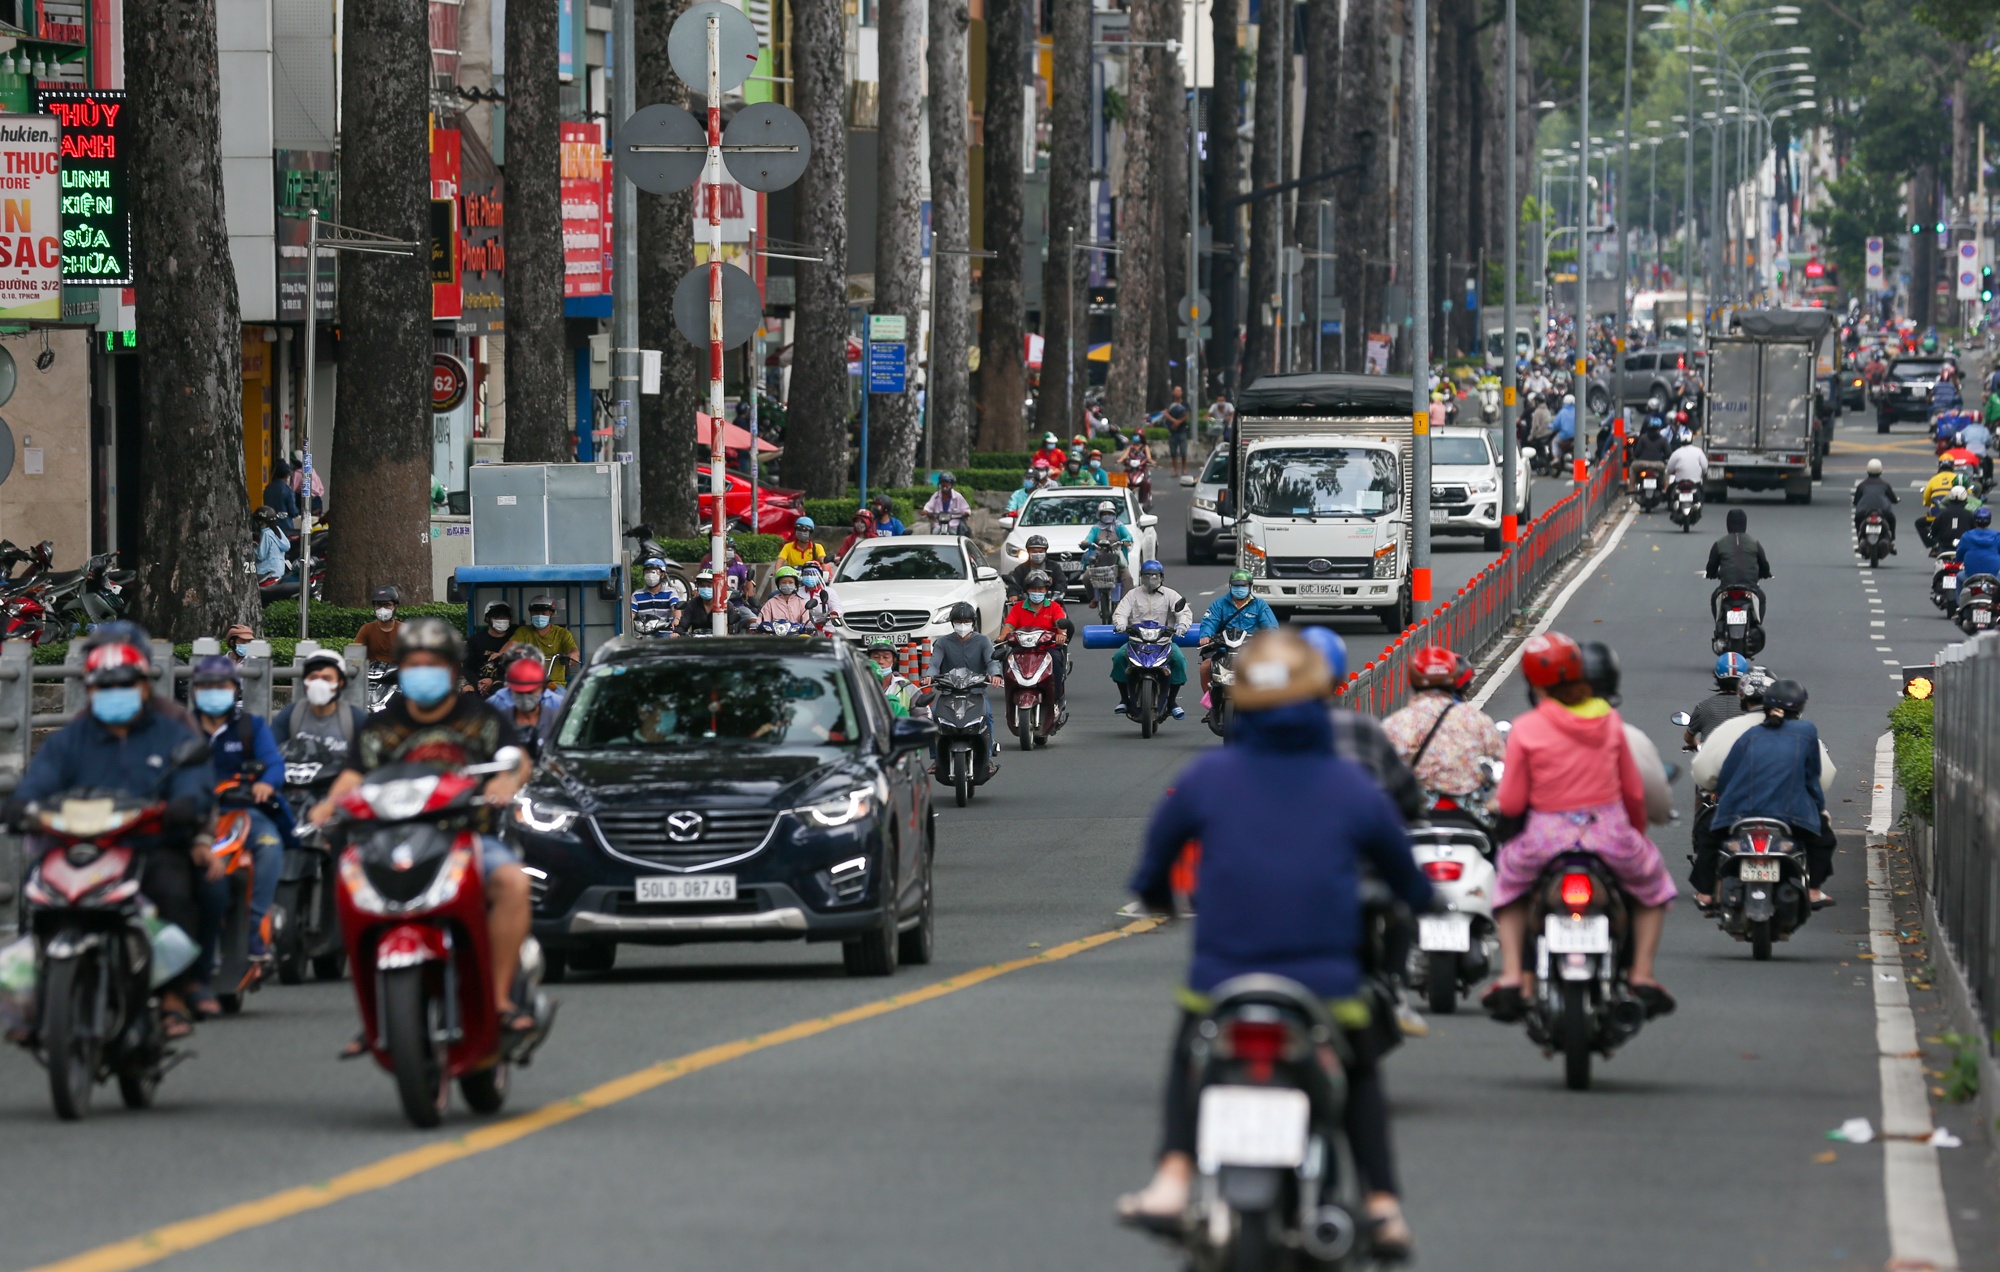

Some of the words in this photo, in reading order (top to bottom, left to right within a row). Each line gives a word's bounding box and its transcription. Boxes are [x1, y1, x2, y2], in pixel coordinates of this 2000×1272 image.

[49, 97, 120, 127] THÙY
[61, 134, 116, 159] ANH
[4, 151, 59, 179] THỤC
[62, 170, 110, 188] LINH
[61, 192, 113, 218] KIỆN
[41, 280, 59, 291] 3/2
[434, 375, 453, 391] 62
[641, 880, 732, 898] 50LD-087.49
